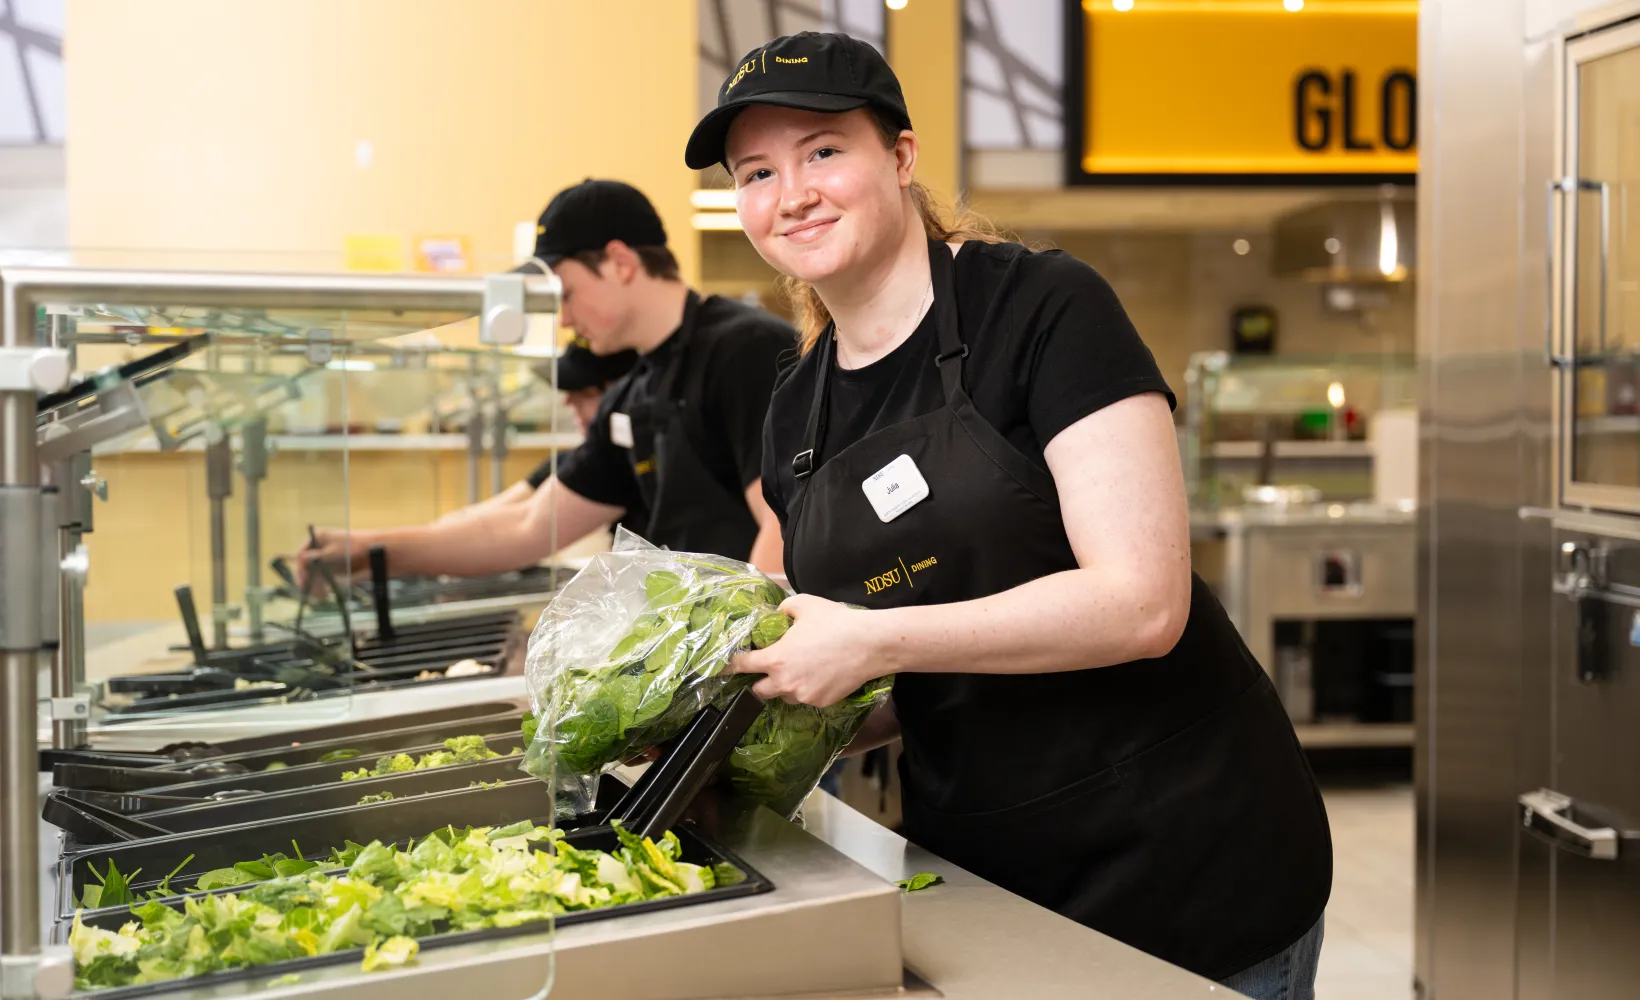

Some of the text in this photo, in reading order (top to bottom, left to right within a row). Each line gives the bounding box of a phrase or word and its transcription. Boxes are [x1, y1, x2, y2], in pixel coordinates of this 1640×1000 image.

[776, 56, 808, 64] DINING
[1294, 69, 1417, 152] GLO
[887, 482, 900, 495] Julia
[864, 557, 938, 595] NDSU DINING
